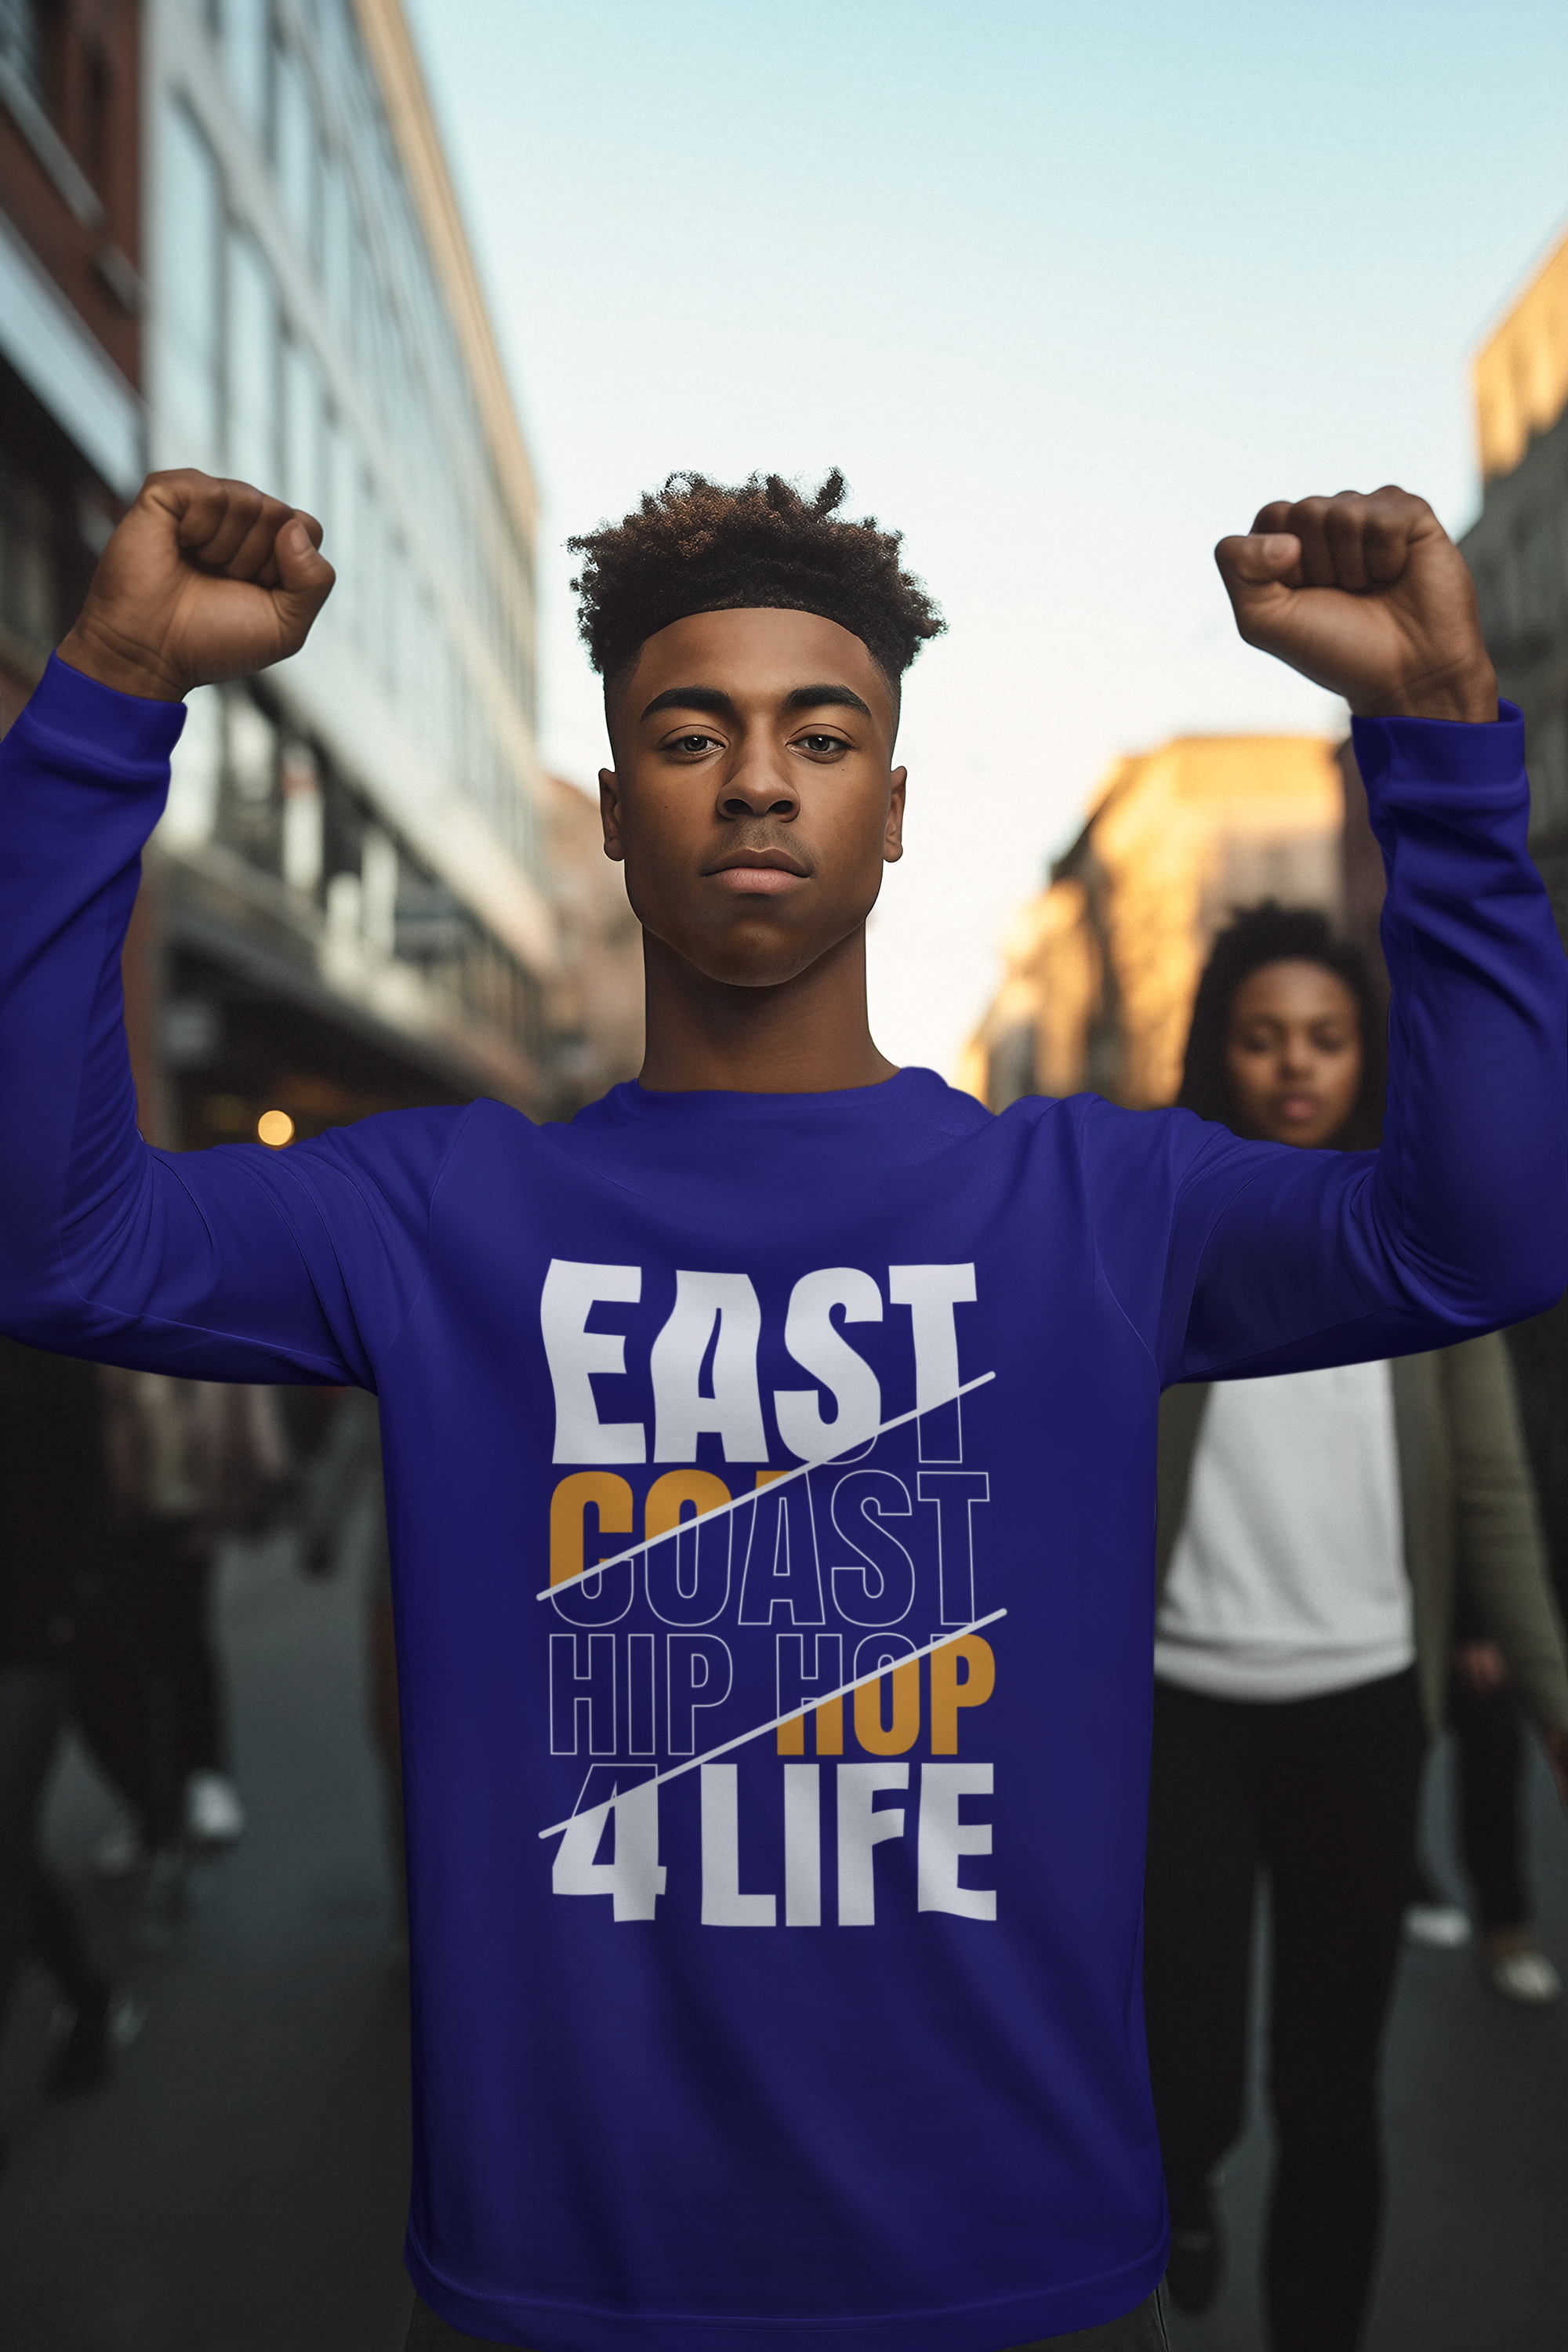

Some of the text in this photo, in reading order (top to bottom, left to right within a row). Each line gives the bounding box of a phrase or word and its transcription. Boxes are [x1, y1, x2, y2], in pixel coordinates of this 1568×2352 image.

[540, 1258, 976, 1464] EAST
[550, 1468, 989, 1626] COAST
[550, 1633, 995, 1755] HIP HOP
[552, 1762, 996, 1926] 4 LIFE
